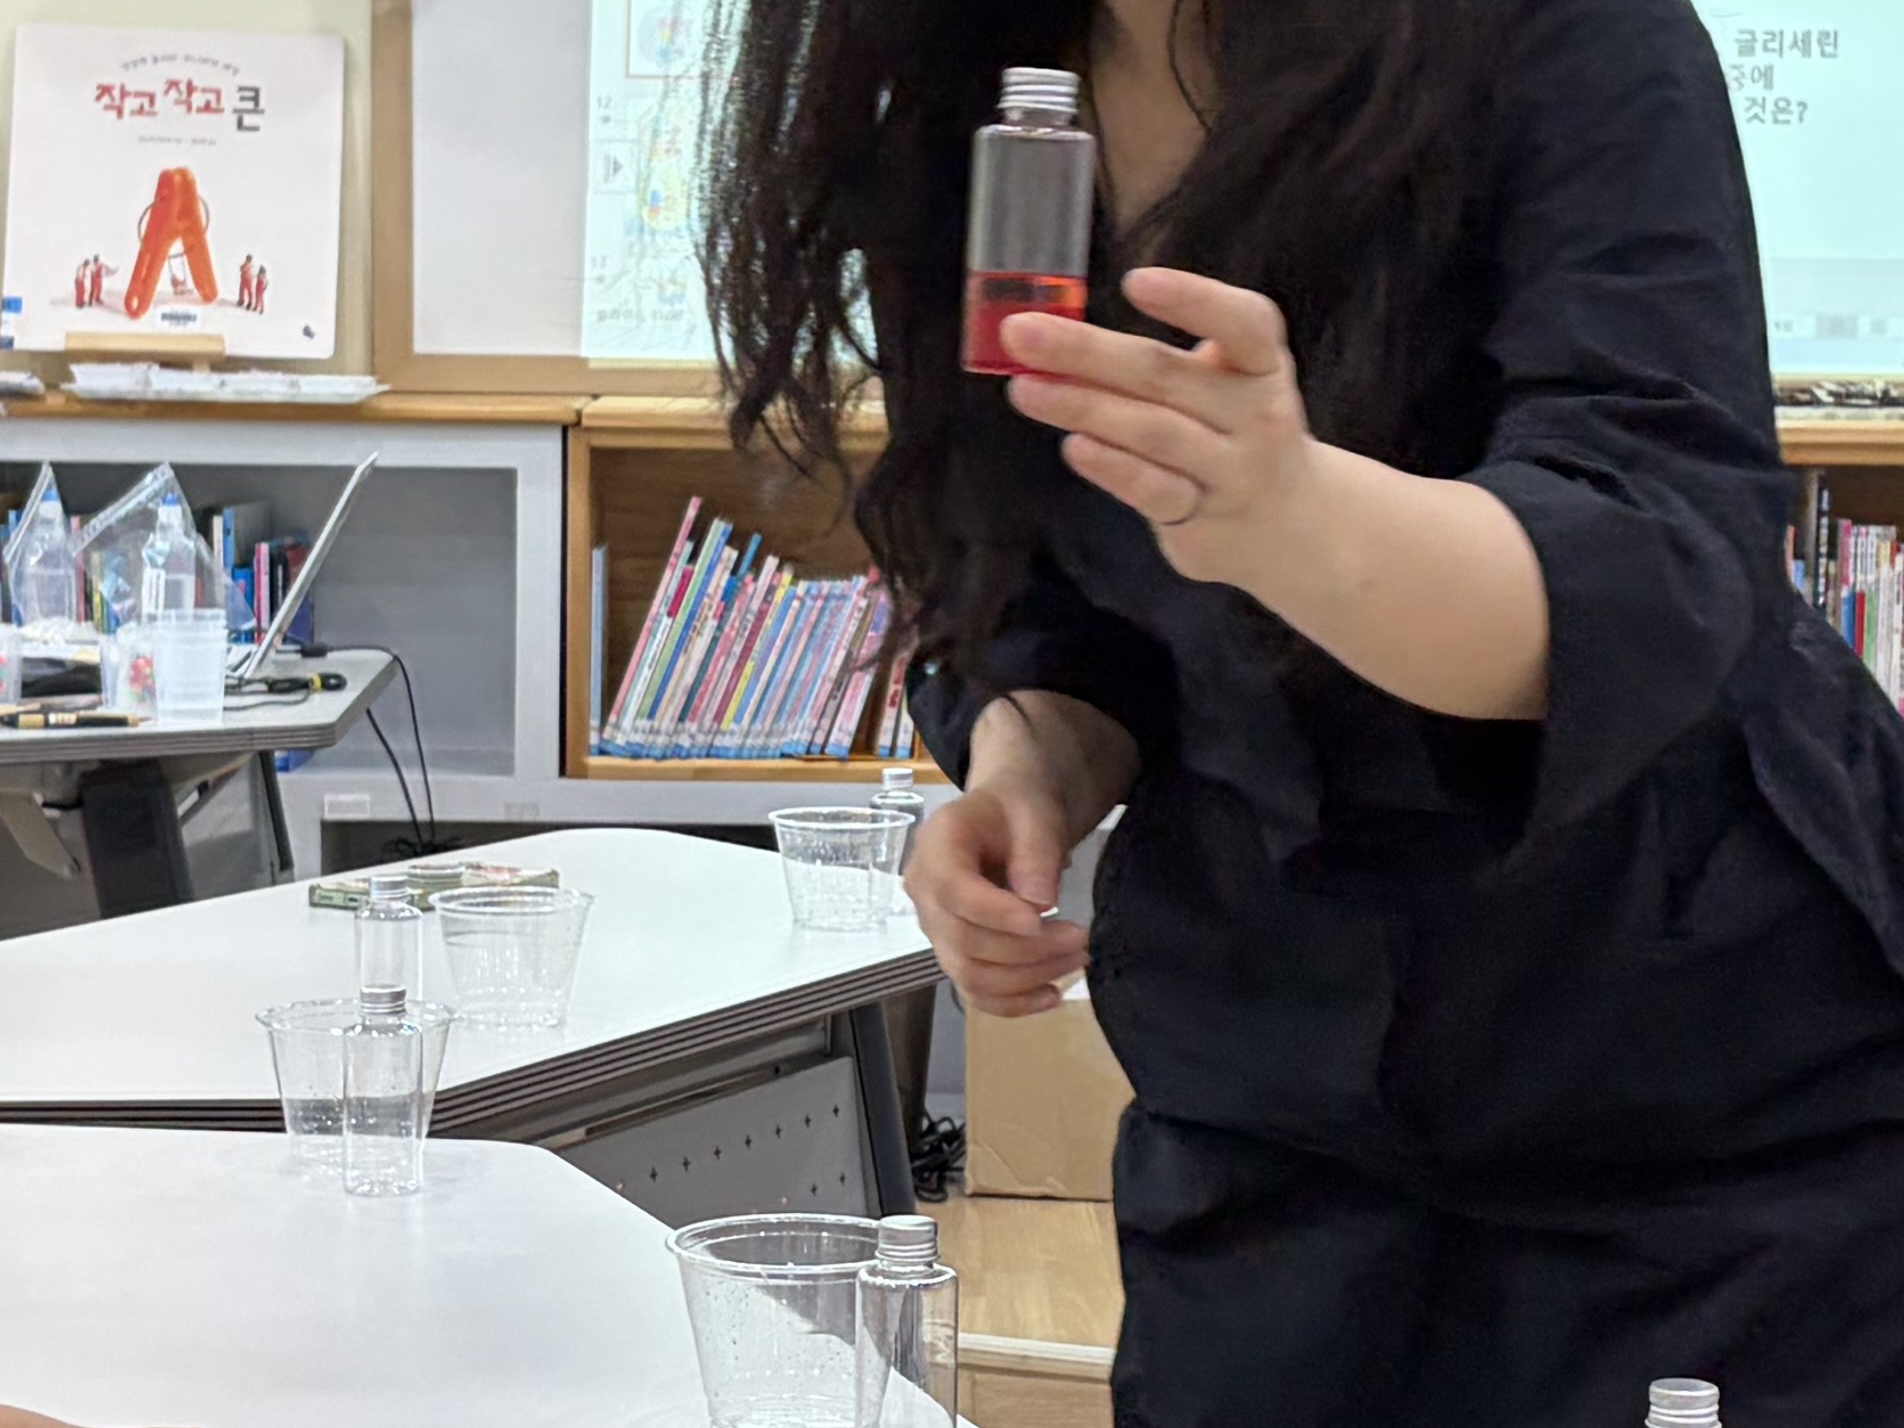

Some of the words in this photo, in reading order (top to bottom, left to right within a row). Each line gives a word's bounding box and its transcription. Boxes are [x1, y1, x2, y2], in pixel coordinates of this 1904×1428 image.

[1734, 28, 1839, 59] 글리세린
[94, 83, 158, 120] 작고
[163, 78, 225, 114] 작고
[232, 85, 265, 132] 큰
[1744, 96, 1809, 125] 것은?
